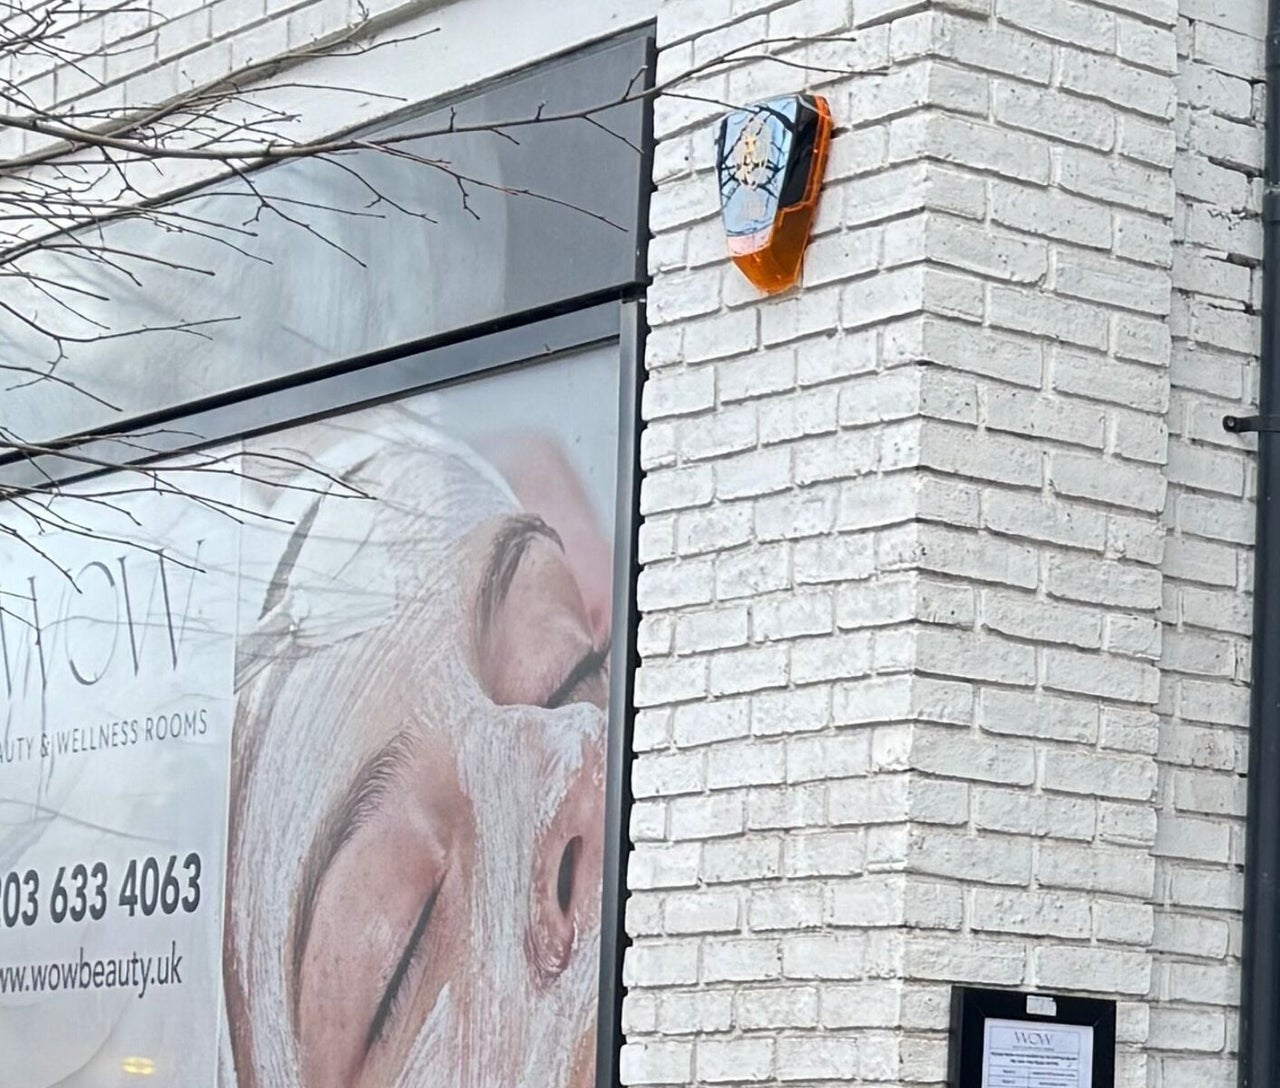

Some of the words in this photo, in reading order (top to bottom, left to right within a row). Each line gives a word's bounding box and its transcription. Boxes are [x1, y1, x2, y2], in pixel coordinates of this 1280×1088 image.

[57, 719, 138, 754] WELLNESS
[145, 708, 207, 742] ROOMS
[0, 869, 39, 928] 03
[50, 861, 108, 923] 633
[118, 852, 202, 917] 4063
